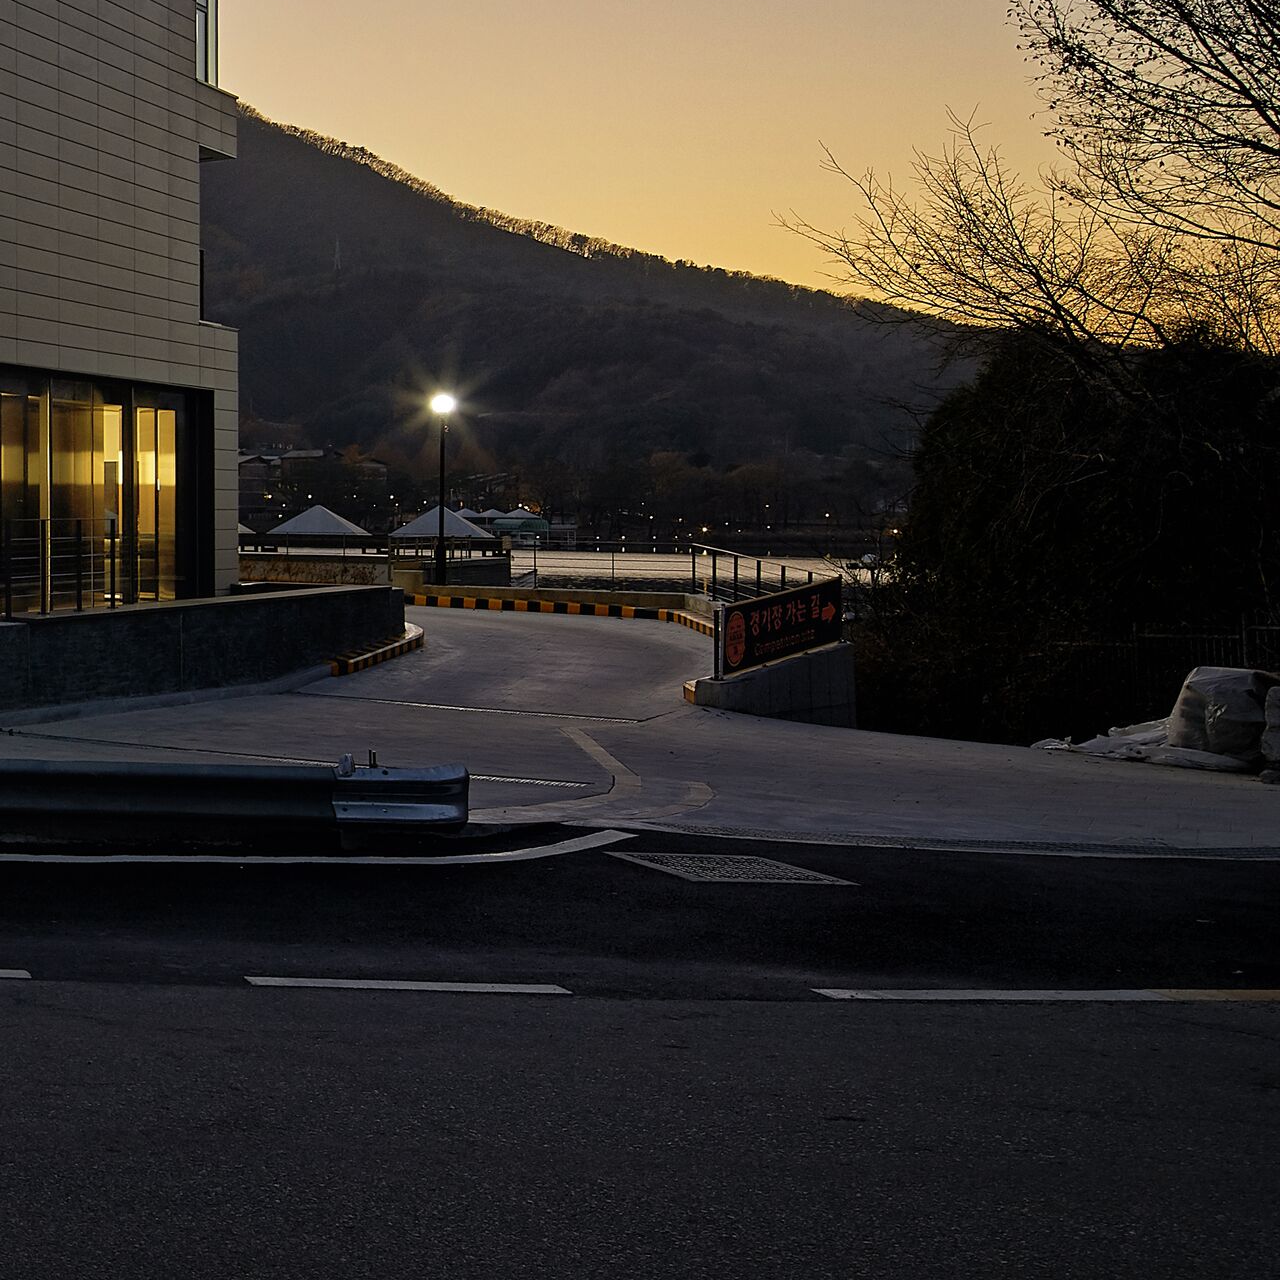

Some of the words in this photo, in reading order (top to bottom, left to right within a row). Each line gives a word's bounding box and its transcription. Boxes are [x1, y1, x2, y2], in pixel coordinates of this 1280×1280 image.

[750, 606, 783, 637] 경기장
[786, 599, 807, 625] 가는
[809, 594, 821, 619] 길
